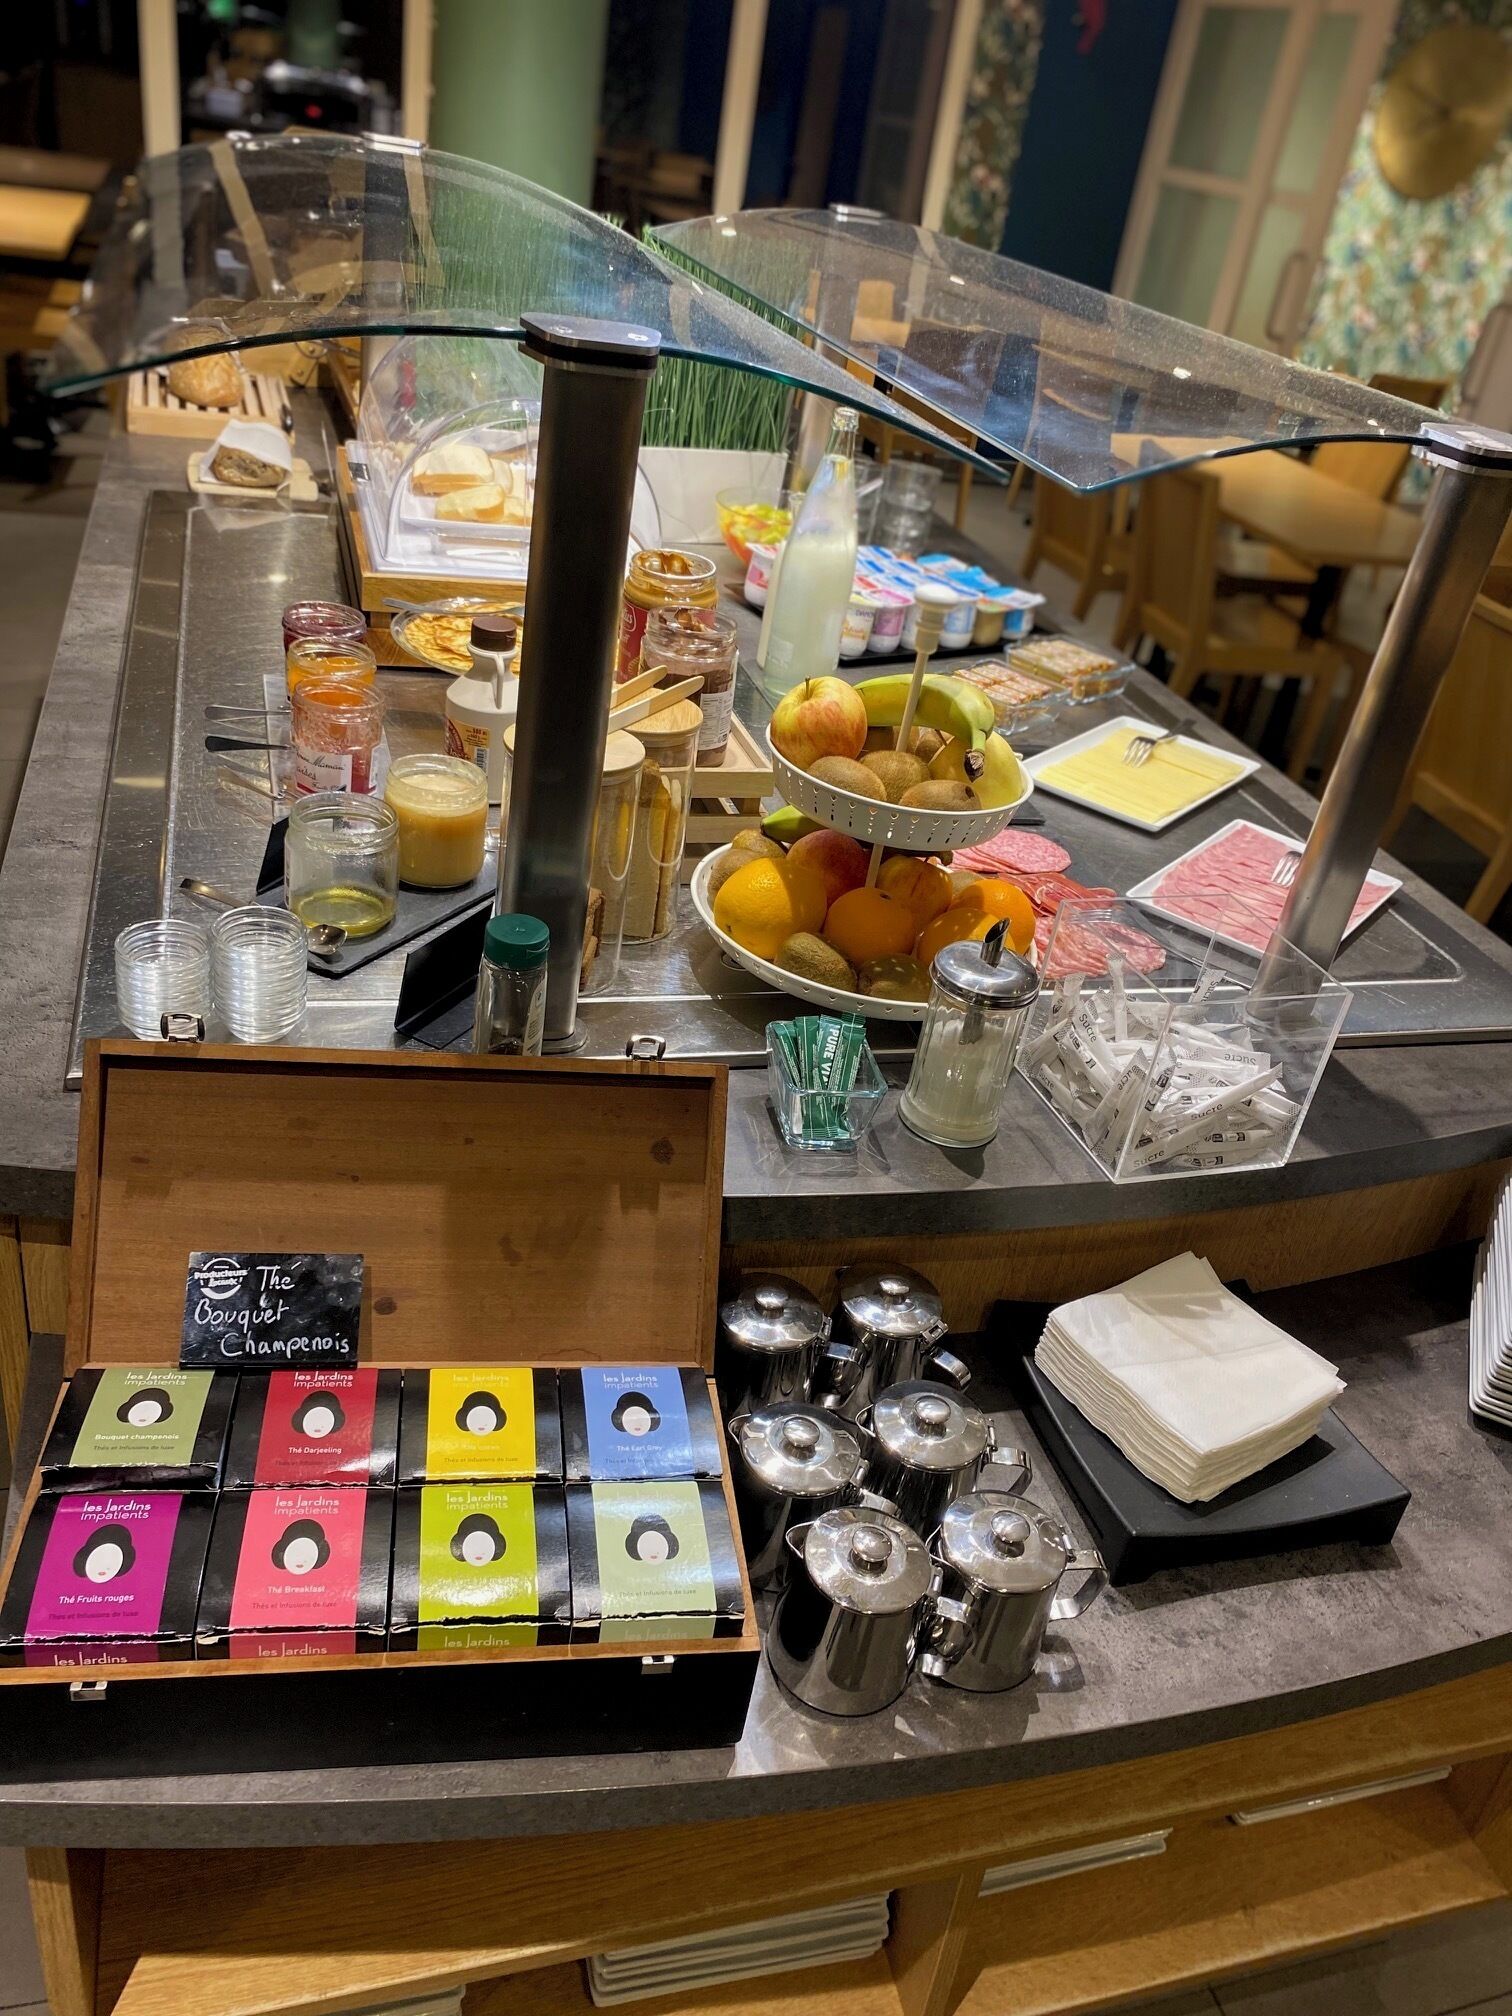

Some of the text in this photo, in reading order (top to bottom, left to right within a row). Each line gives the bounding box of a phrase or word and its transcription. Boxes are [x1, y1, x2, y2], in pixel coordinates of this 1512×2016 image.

[1078, 1013, 1098, 1043] Sucre
[823, 1028, 840, 1060] PURE
[1223, 1053, 1257, 1066] Sucre
[1190, 1103, 1224, 1121] Sucre
[1133, 1149, 1166, 1168] Sucre
[256, 1261, 302, 1292] Thé
[194, 1297, 290, 1334] Bouquet
[219, 1332, 350, 1360] Champenois
[126, 1370, 188, 1381] les Jardins
[294, 1370, 354, 1382] les Jardins
[603, 1372, 658, 1383] les Jardins
[124, 1379, 186, 1387] impatients
[293, 1380, 353, 1389] impatients
[604, 1381, 659, 1390] impatients
[94, 1433, 180, 1441] Bouquet champenois
[288, 1446, 342, 1455] Thé Darjeeling
[275, 1494, 340, 1508] les Jardins
[445, 1491, 509, 1504] les Jardins
[83, 1498, 152, 1513] les Jardins
[274, 1505, 340, 1517] impatients
[446, 1501, 509, 1512] impatients
[80, 1510, 150, 1523] impatients
[284, 1584, 326, 1594] Breakfast
[58, 1593, 135, 1604] Thé Fruits rouges
[444, 1633, 511, 1649] les Jardins
[258, 1641, 328, 1658] les Jardins
[54, 1650, 129, 1667] les Jardins
